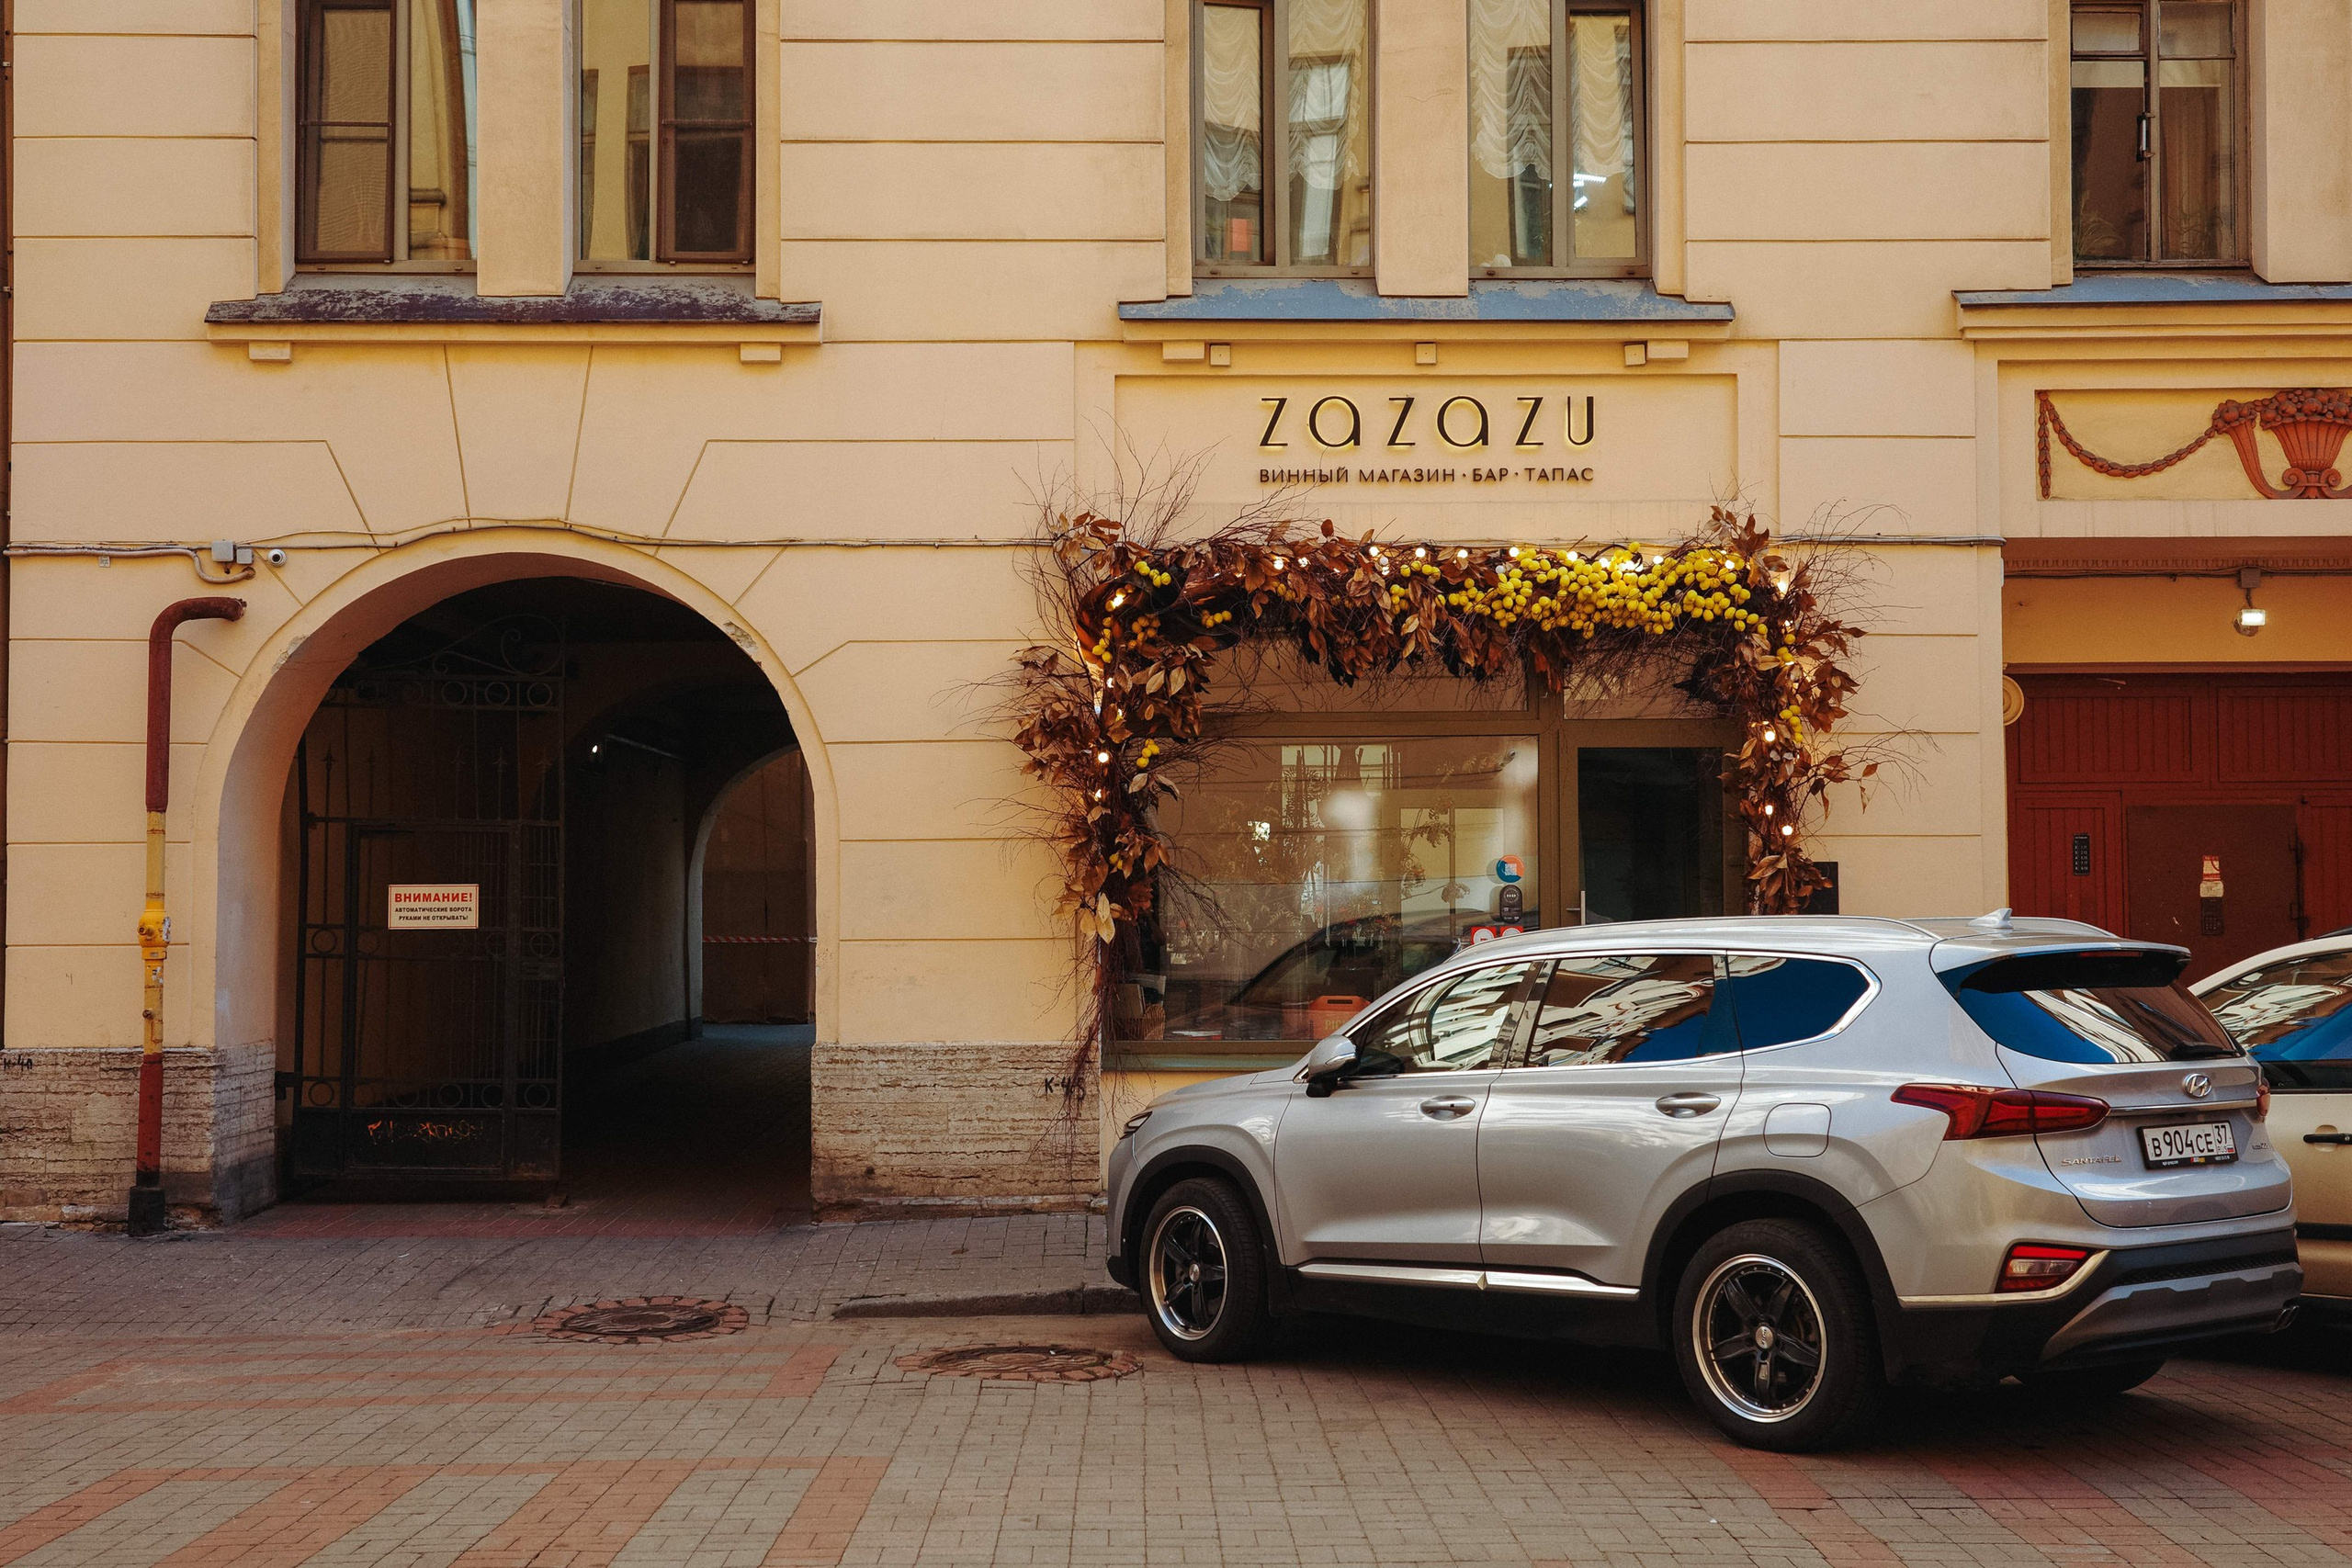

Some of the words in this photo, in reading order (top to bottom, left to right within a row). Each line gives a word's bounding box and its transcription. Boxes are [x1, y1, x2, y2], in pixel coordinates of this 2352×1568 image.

[1260, 467, 1349, 483] ВИННЫЙ
[1359, 468, 1455, 483] МАГАЗИН
[1472, 468, 1509, 482] БАР
[1524, 468, 1594, 482] ТАПАС
[395, 893, 472, 902] ВНИМАНИЕ!
